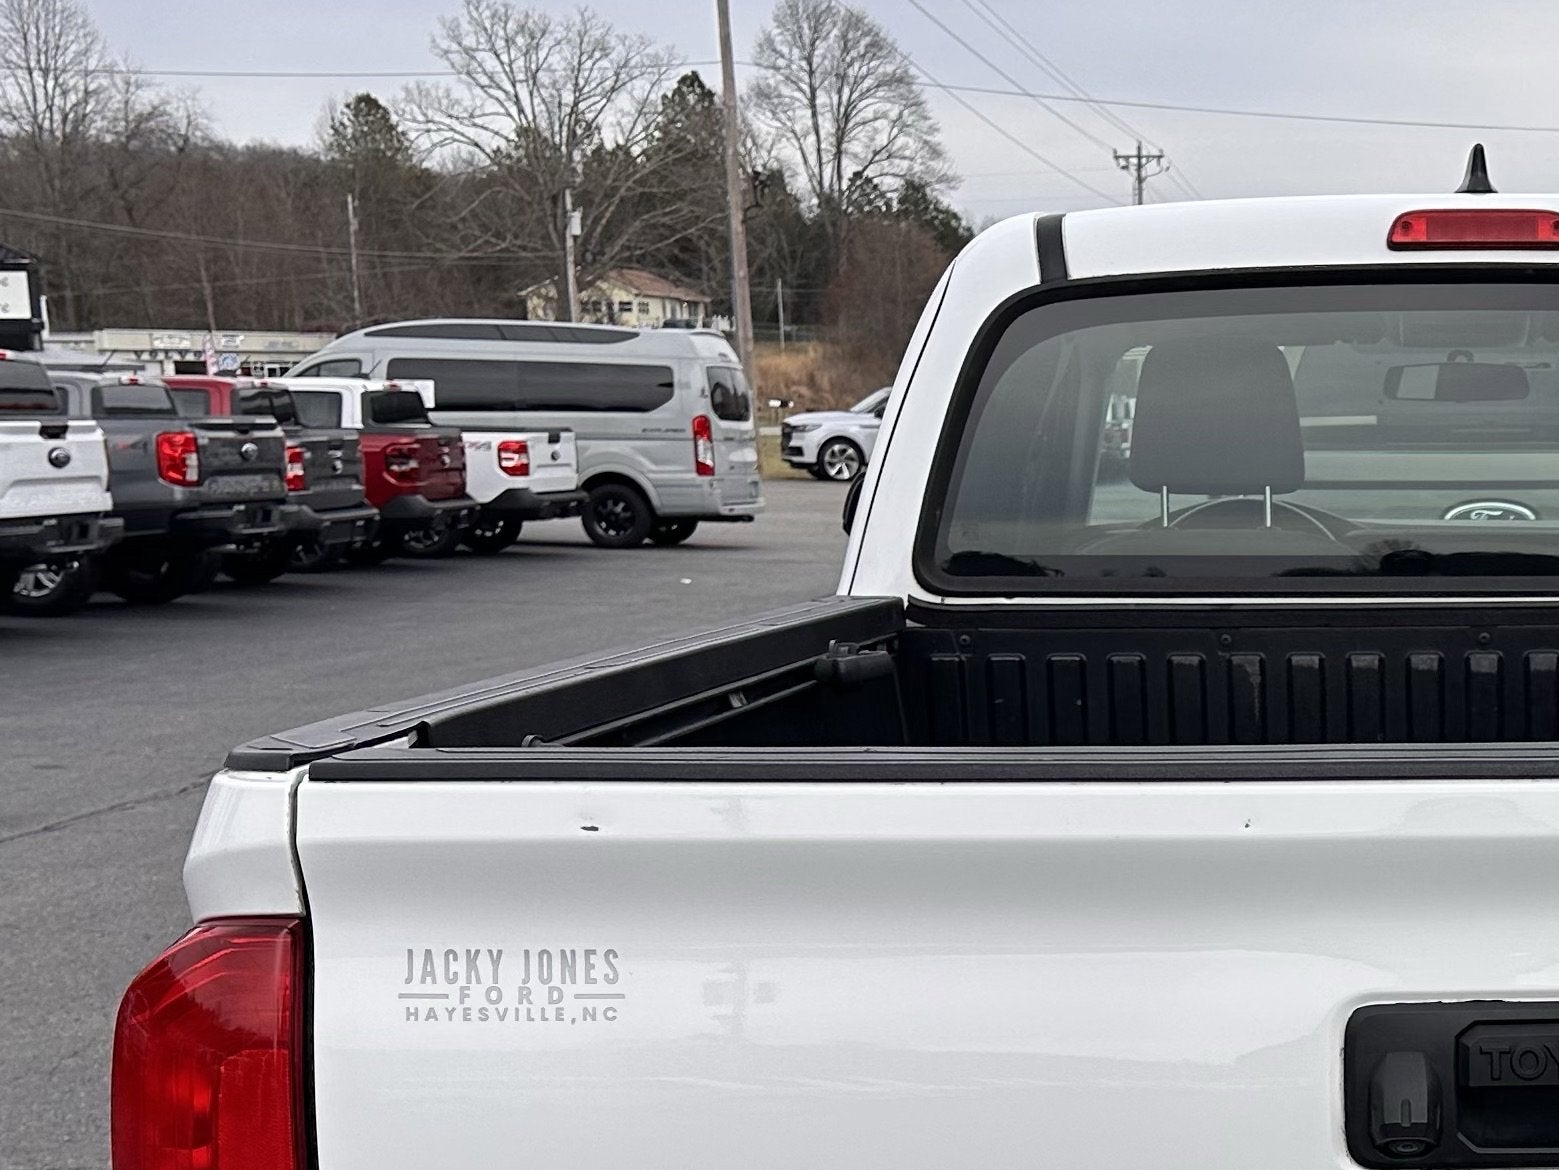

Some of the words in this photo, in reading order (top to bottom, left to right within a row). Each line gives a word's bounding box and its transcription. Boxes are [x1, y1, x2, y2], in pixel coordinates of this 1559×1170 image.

[404, 948, 503, 985] JACKY
[521, 948, 620, 985] JONES
[458, 985, 565, 1005] FORD
